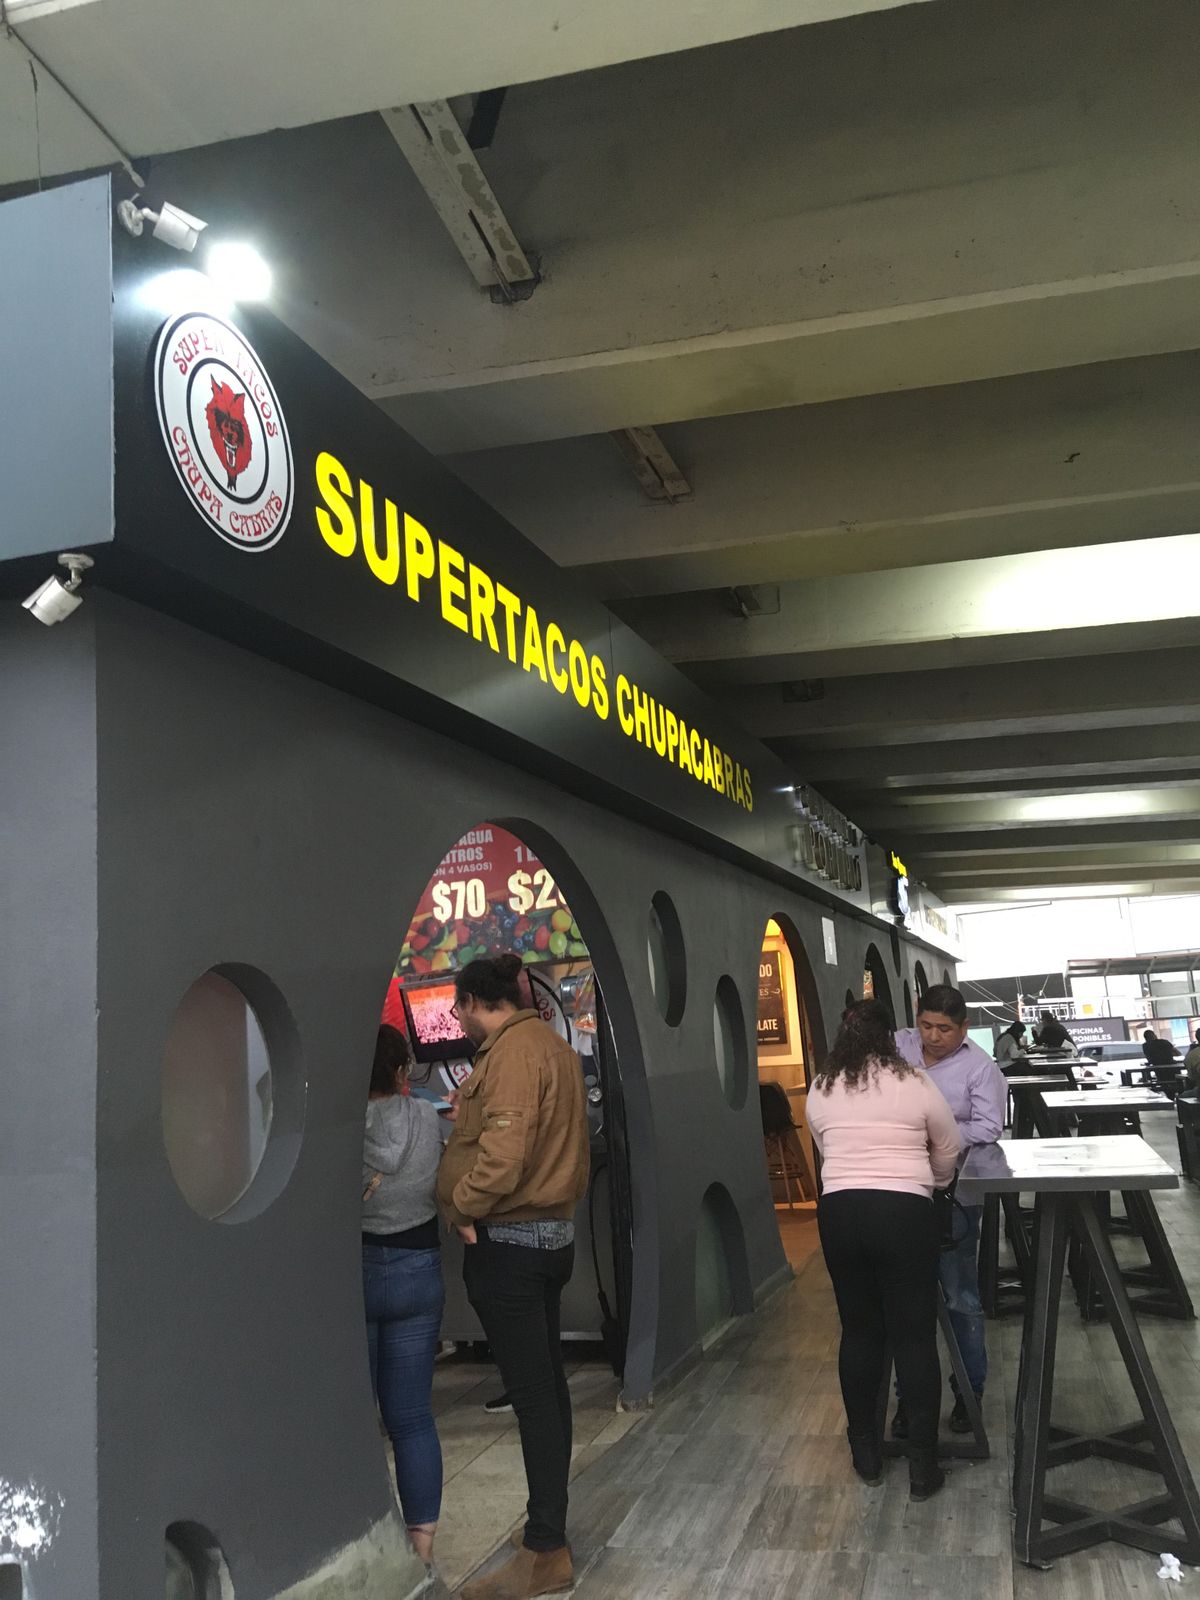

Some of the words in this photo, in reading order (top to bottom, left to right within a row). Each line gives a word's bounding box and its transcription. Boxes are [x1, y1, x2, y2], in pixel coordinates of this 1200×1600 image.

[172, 425, 223, 522] CHUPA
[315, 451, 609, 720] SUPERTACOS
[615, 674, 754, 813] CHUPACABRAS
[448, 866, 455, 876] 4
[457, 862, 493, 874] VASOS)
[513, 845, 523, 864] 1
[431, 878, 487, 924] $70
[507, 868, 567, 915] $2
[757, 1018, 779, 1032] LATE
[1066, 1027, 1104, 1035] OFICINAS
